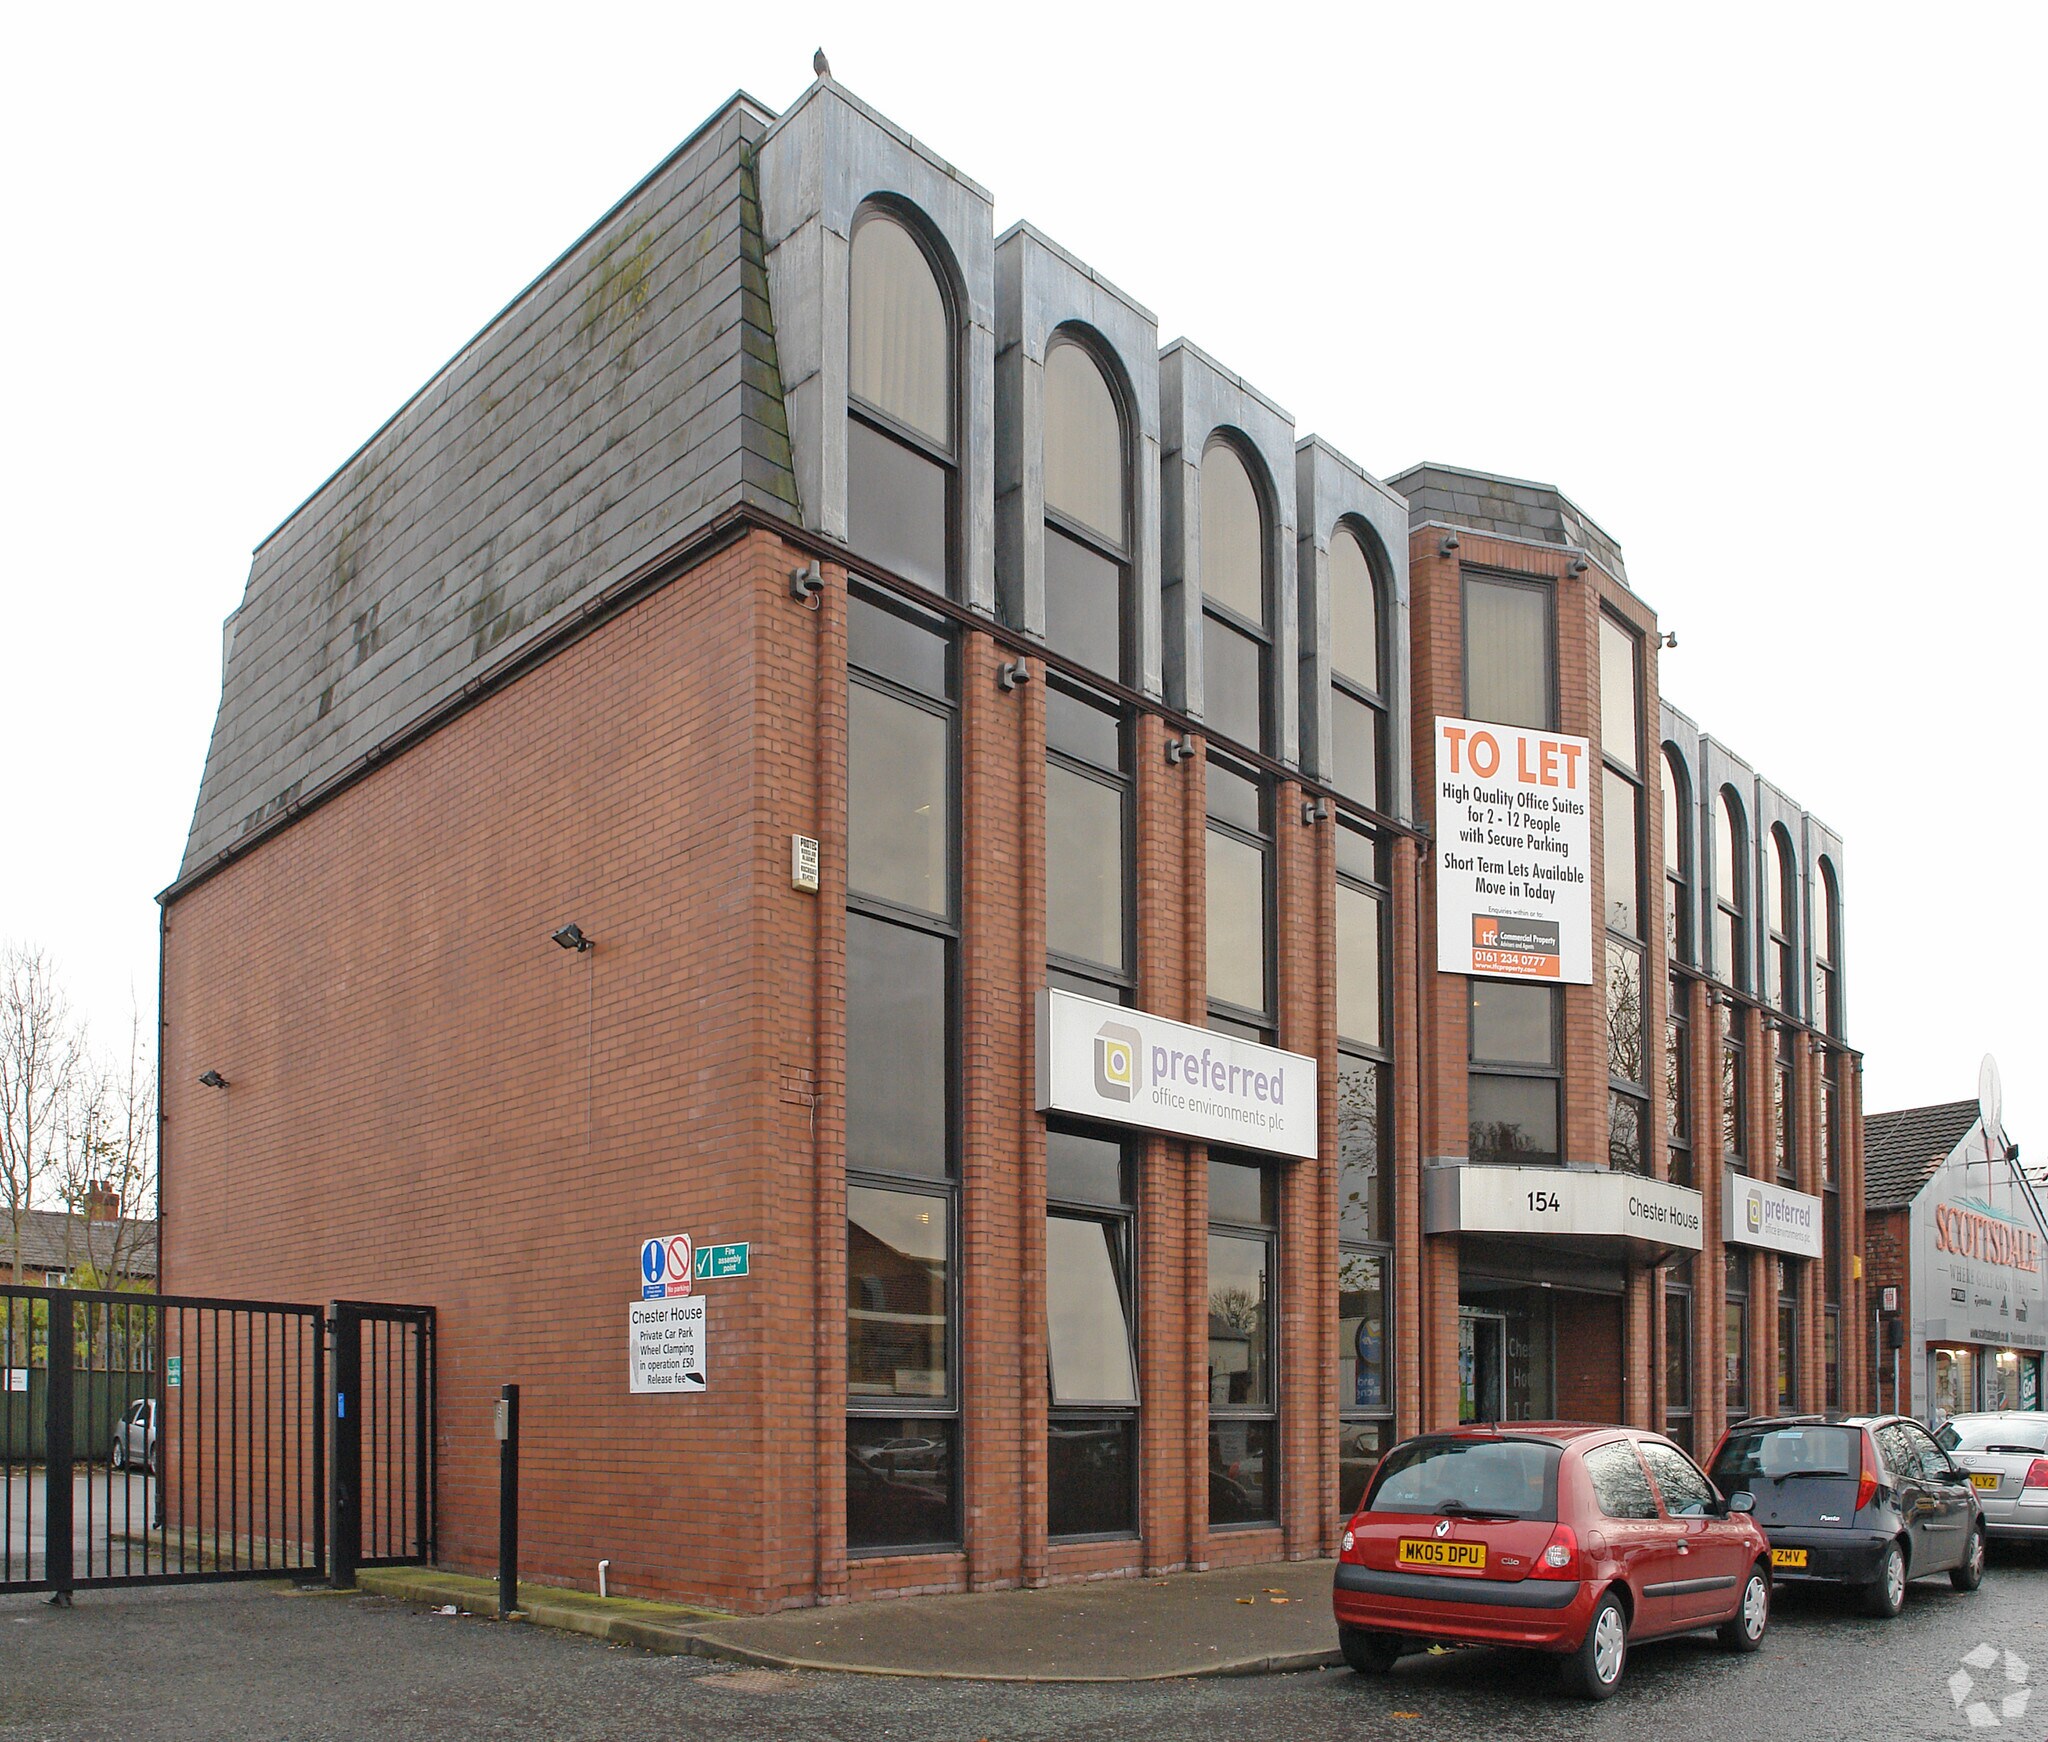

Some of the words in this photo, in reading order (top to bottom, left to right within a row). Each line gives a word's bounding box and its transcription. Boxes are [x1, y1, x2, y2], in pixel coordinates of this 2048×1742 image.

[1443, 726, 1501, 779] TO
[1517, 736, 1582, 790] LET
[1442, 782, 1469, 804] High
[1473, 786, 1514, 810] Quality
[1517, 792, 1549, 811] Office
[1552, 796, 1584, 815] Suites
[1468, 805, 1484, 823] for
[1487, 808, 1494, 824] 2
[1507, 811, 1520, 828] 12
[1523, 813, 1561, 835] People
[1459, 826, 1484, 844] with
[1487, 829, 1524, 848] Secure
[1527, 834, 1569, 858] Parking
[1444, 852, 1474, 871] Short
[1477, 856, 1504, 875] Term
[1507, 859, 1529, 878] Lets
[1532, 863, 1584, 883] Available
[1475, 876, 1506, 895] Move
[1509, 881, 1520, 897] in
[1523, 882, 1556, 904] Today
[1488, 905, 1512, 915] Enquiries
[1513, 908, 1529, 917] within
[1482, 930, 1498, 946] tfc
[1500, 931, 1532, 943] Commercial
[1533, 934, 1556, 947] Property
[1475, 950, 1498, 963] 0161
[1500, 953, 1519, 965] 234
[1521, 955, 1546, 967] 0777
[1475, 963, 1537, 974] www.tfcproperty.com
[1152, 1045, 1284, 1105] preferred
[1152, 1087, 1186, 1110] office
[1188, 1096, 1267, 1128] environments
[1268, 1113, 1285, 1133] plc
[1527, 1191, 1561, 1213] 154
[1628, 1196, 1668, 1222] Chester
[1669, 1207, 1699, 1230] House
[1765, 1198, 1811, 1228] preferred
[1936, 1203, 2039, 1273] SCOTTSDALE
[718, 1254, 742, 1265] assembly
[724, 1247, 736, 1256] Fire
[723, 1263, 737, 1274] point
[674, 1284, 690, 1294] parking
[632, 1309, 668, 1325] Chester
[670, 1307, 703, 1321] House
[640, 1330, 663, 1341] Private
[664, 1328, 677, 1340] Car
[678, 1326, 694, 1339] Park
[640, 1344, 661, 1356] Wheel
[662, 1342, 694, 1356] Clamping
[639, 1359, 646, 1371] in
[647, 1358, 680, 1372] operation
[682, 1357, 695, 1369] £50
[647, 1373, 673, 1385] Release
[674, 1372, 686, 1384] fee
[1975, 1477, 1995, 1487] LYZ
[1820, 1514, 1840, 1522] Punto
[1405, 1543, 1444, 1561] MK05
[1448, 1546, 1479, 1564] DPU
[1776, 1550, 1800, 1563] ZMV
